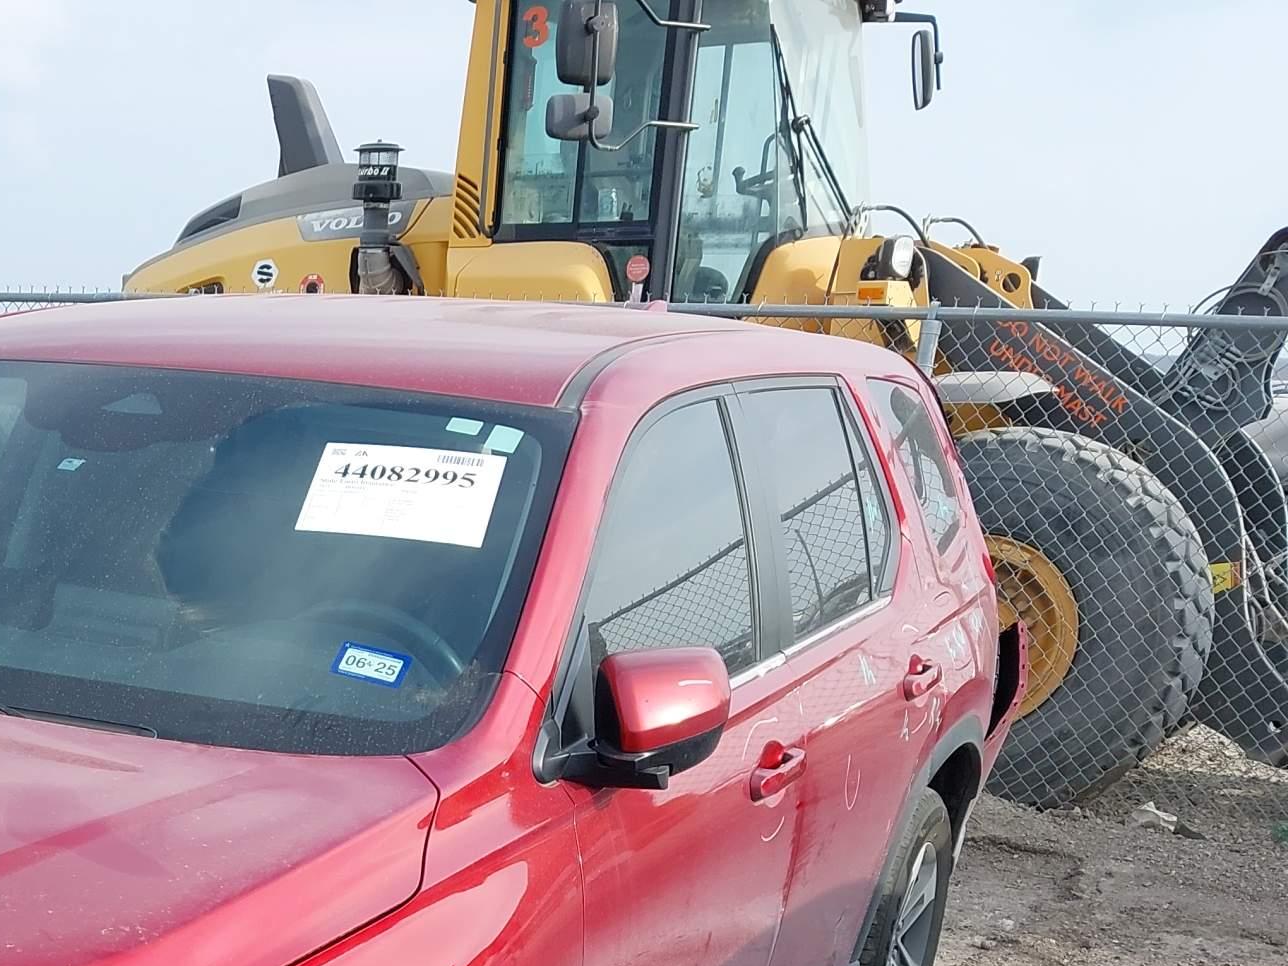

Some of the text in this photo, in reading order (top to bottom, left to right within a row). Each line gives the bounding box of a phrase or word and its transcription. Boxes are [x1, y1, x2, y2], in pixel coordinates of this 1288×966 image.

[523, 6, 549, 48] 3
[310, 211, 402, 233] VOLO
[1028, 334, 1074, 367] NOT
[1073, 367, 1129, 413] WALK
[334, 462, 478, 488] 44082995
